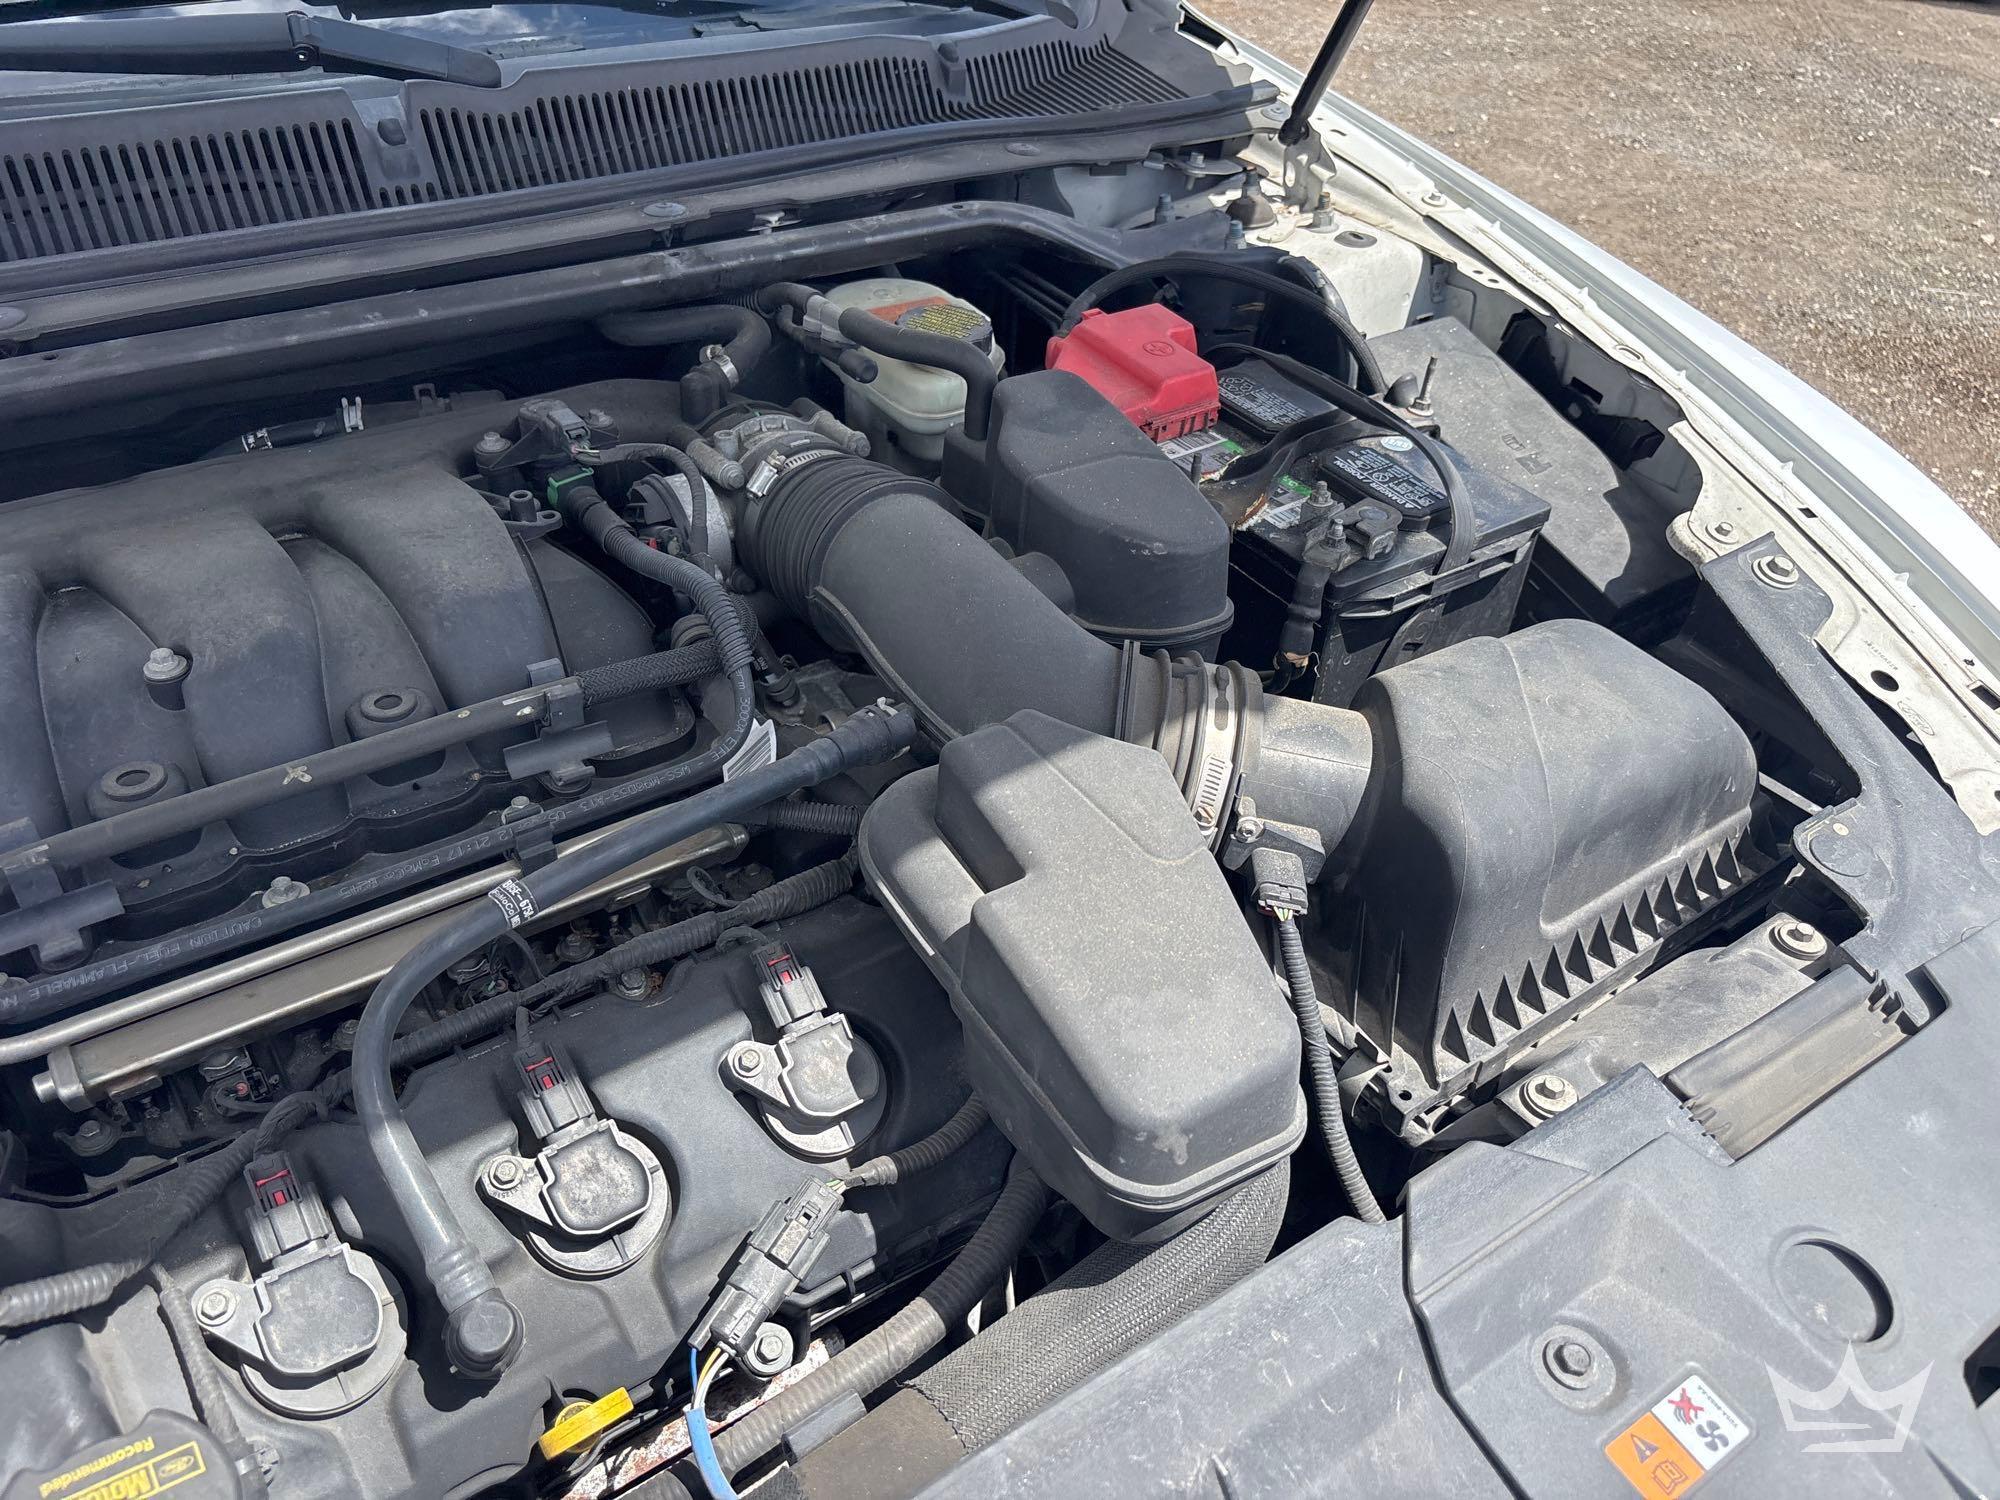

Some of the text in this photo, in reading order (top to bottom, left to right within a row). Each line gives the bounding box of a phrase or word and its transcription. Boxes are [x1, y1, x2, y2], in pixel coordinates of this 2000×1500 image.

[1333, 460, 1365, 480] POISON
[1370, 482, 1406, 505] DANGER
[189, 916, 263, 949] CAUTION
[39, 1436, 155, 1499] Recommended
